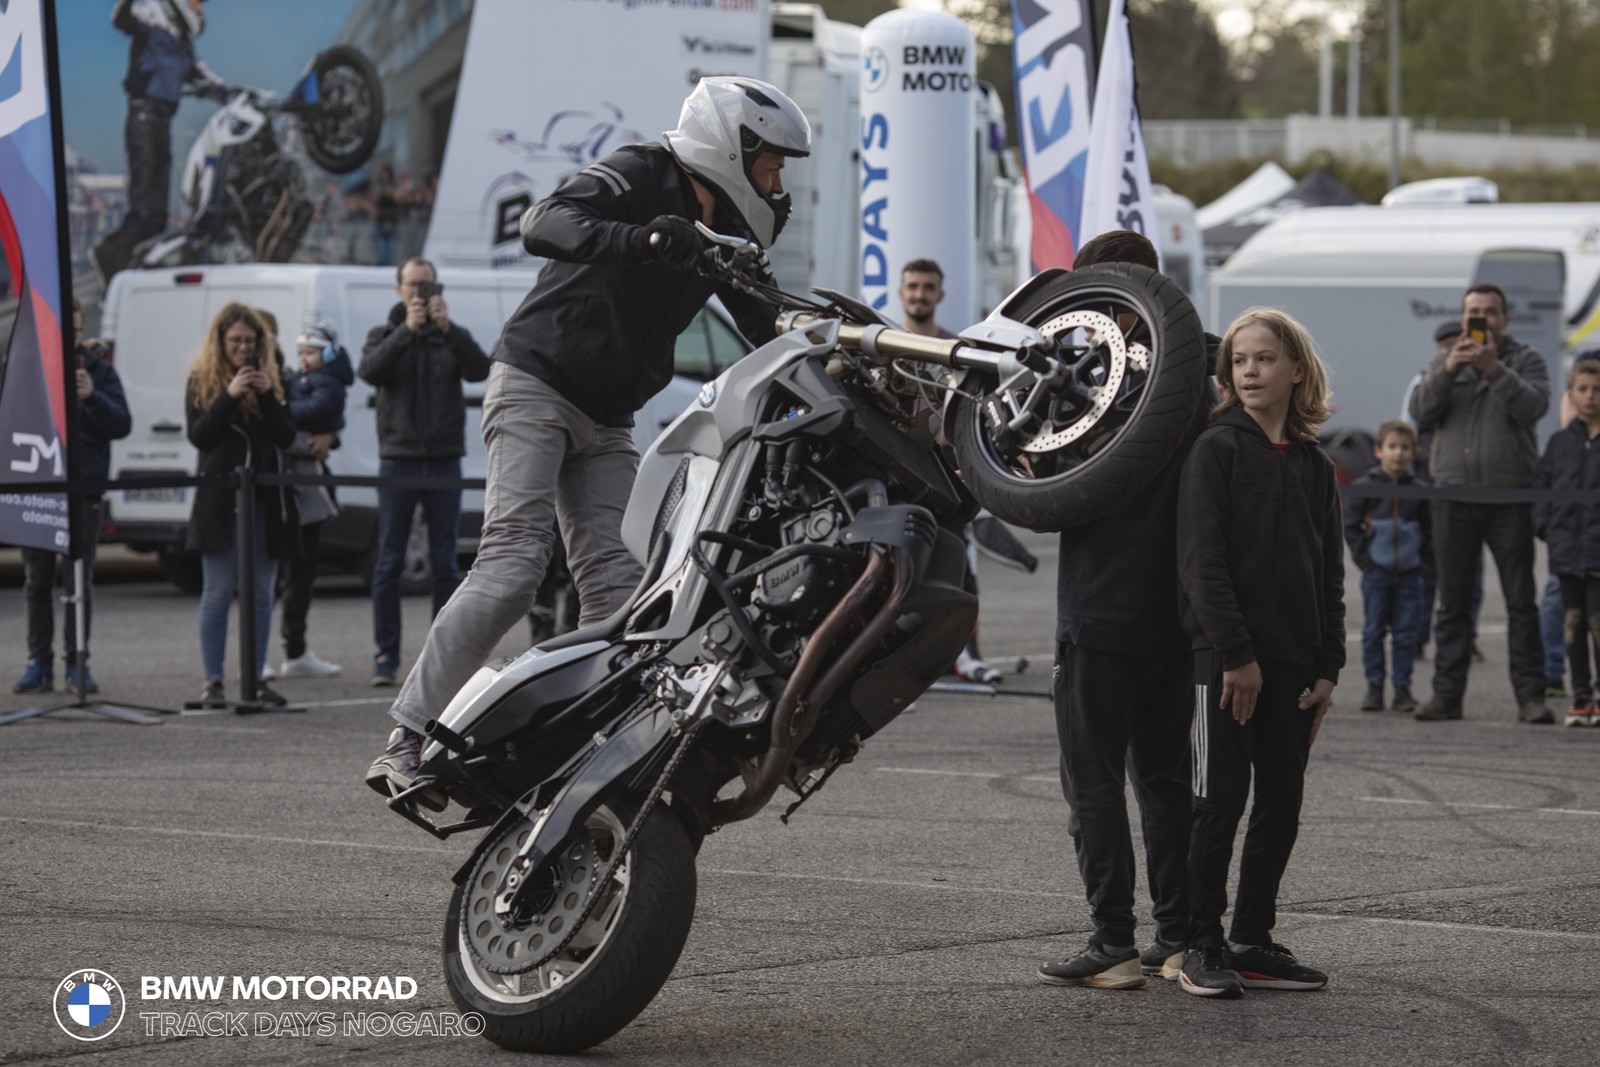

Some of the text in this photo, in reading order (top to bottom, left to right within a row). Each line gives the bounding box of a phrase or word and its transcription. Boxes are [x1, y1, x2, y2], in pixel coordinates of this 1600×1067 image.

[903, 46, 966, 65] BMW
[902, 72, 972, 92] MOTO
[770, 563, 800, 589] BMW
